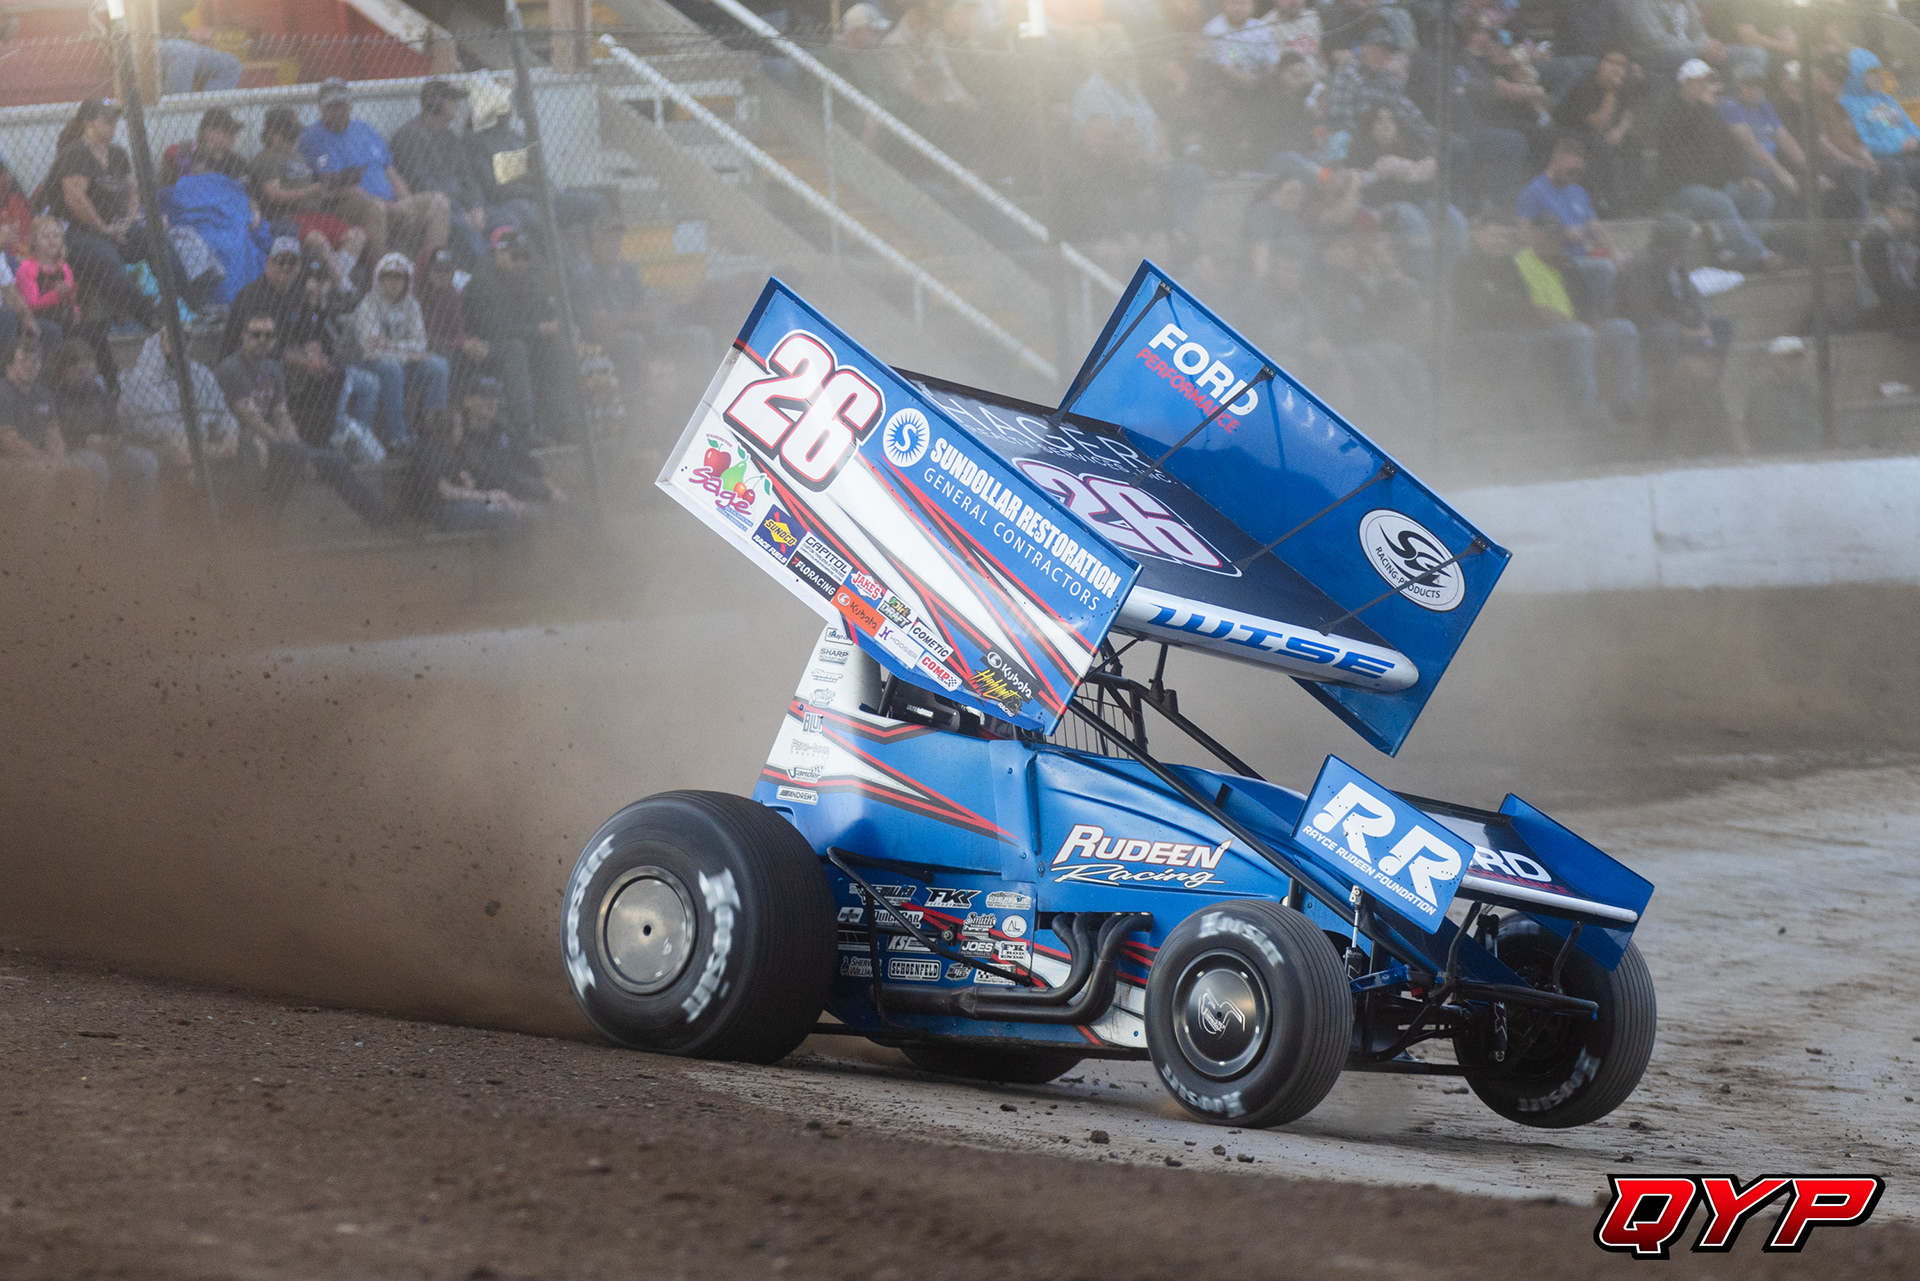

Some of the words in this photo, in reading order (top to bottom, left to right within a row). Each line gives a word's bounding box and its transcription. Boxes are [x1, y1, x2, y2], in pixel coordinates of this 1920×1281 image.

[1148, 323, 1259, 416] FORD
[724, 331, 884, 490] 26
[930, 438, 1023, 522] SUNDOLLAR
[1016, 502, 1122, 599] RESTORATION
[765, 520, 797, 547] SUNOCO
[923, 467, 986, 526] GENERAL
[992, 521, 1100, 611] CONTRACTORS
[753, 534, 772, 552] RACE
[768, 546, 789, 564] FUELS
[805, 536, 847, 574] CAPITOL
[795, 559, 836, 596] FLORACING
[852, 573, 881, 600] JAKES
[850, 602, 878, 630] Kubota
[878, 602, 912, 629] DRAFT
[892, 597, 912, 618] Dirt
[819, 648, 848, 658] SHARP
[890, 635, 918, 660] HOOSIER
[912, 627, 949, 658] COMETIC
[1146, 603, 1396, 680] WISE
[921, 656, 951, 680] COMP
[1000, 662, 1033, 699] Kubota
[997, 702, 1014, 718] RACING
[788, 790, 818, 802] ANDREW'S
[1048, 823, 1234, 870] RUDEEN
[1050, 863, 1226, 890] Racing
[1302, 824, 1337, 851] RAYCE
[1335, 845, 1375, 877] RUDEEN
[1373, 870, 1437, 916] FOUNDATION
[1468, 845, 1552, 882] RD
[964, 911, 996, 927] Smith
[961, 942, 994, 953] JOES
[1004, 944, 1025, 952] FK
[891, 960, 938, 977] SCHOENFELD
